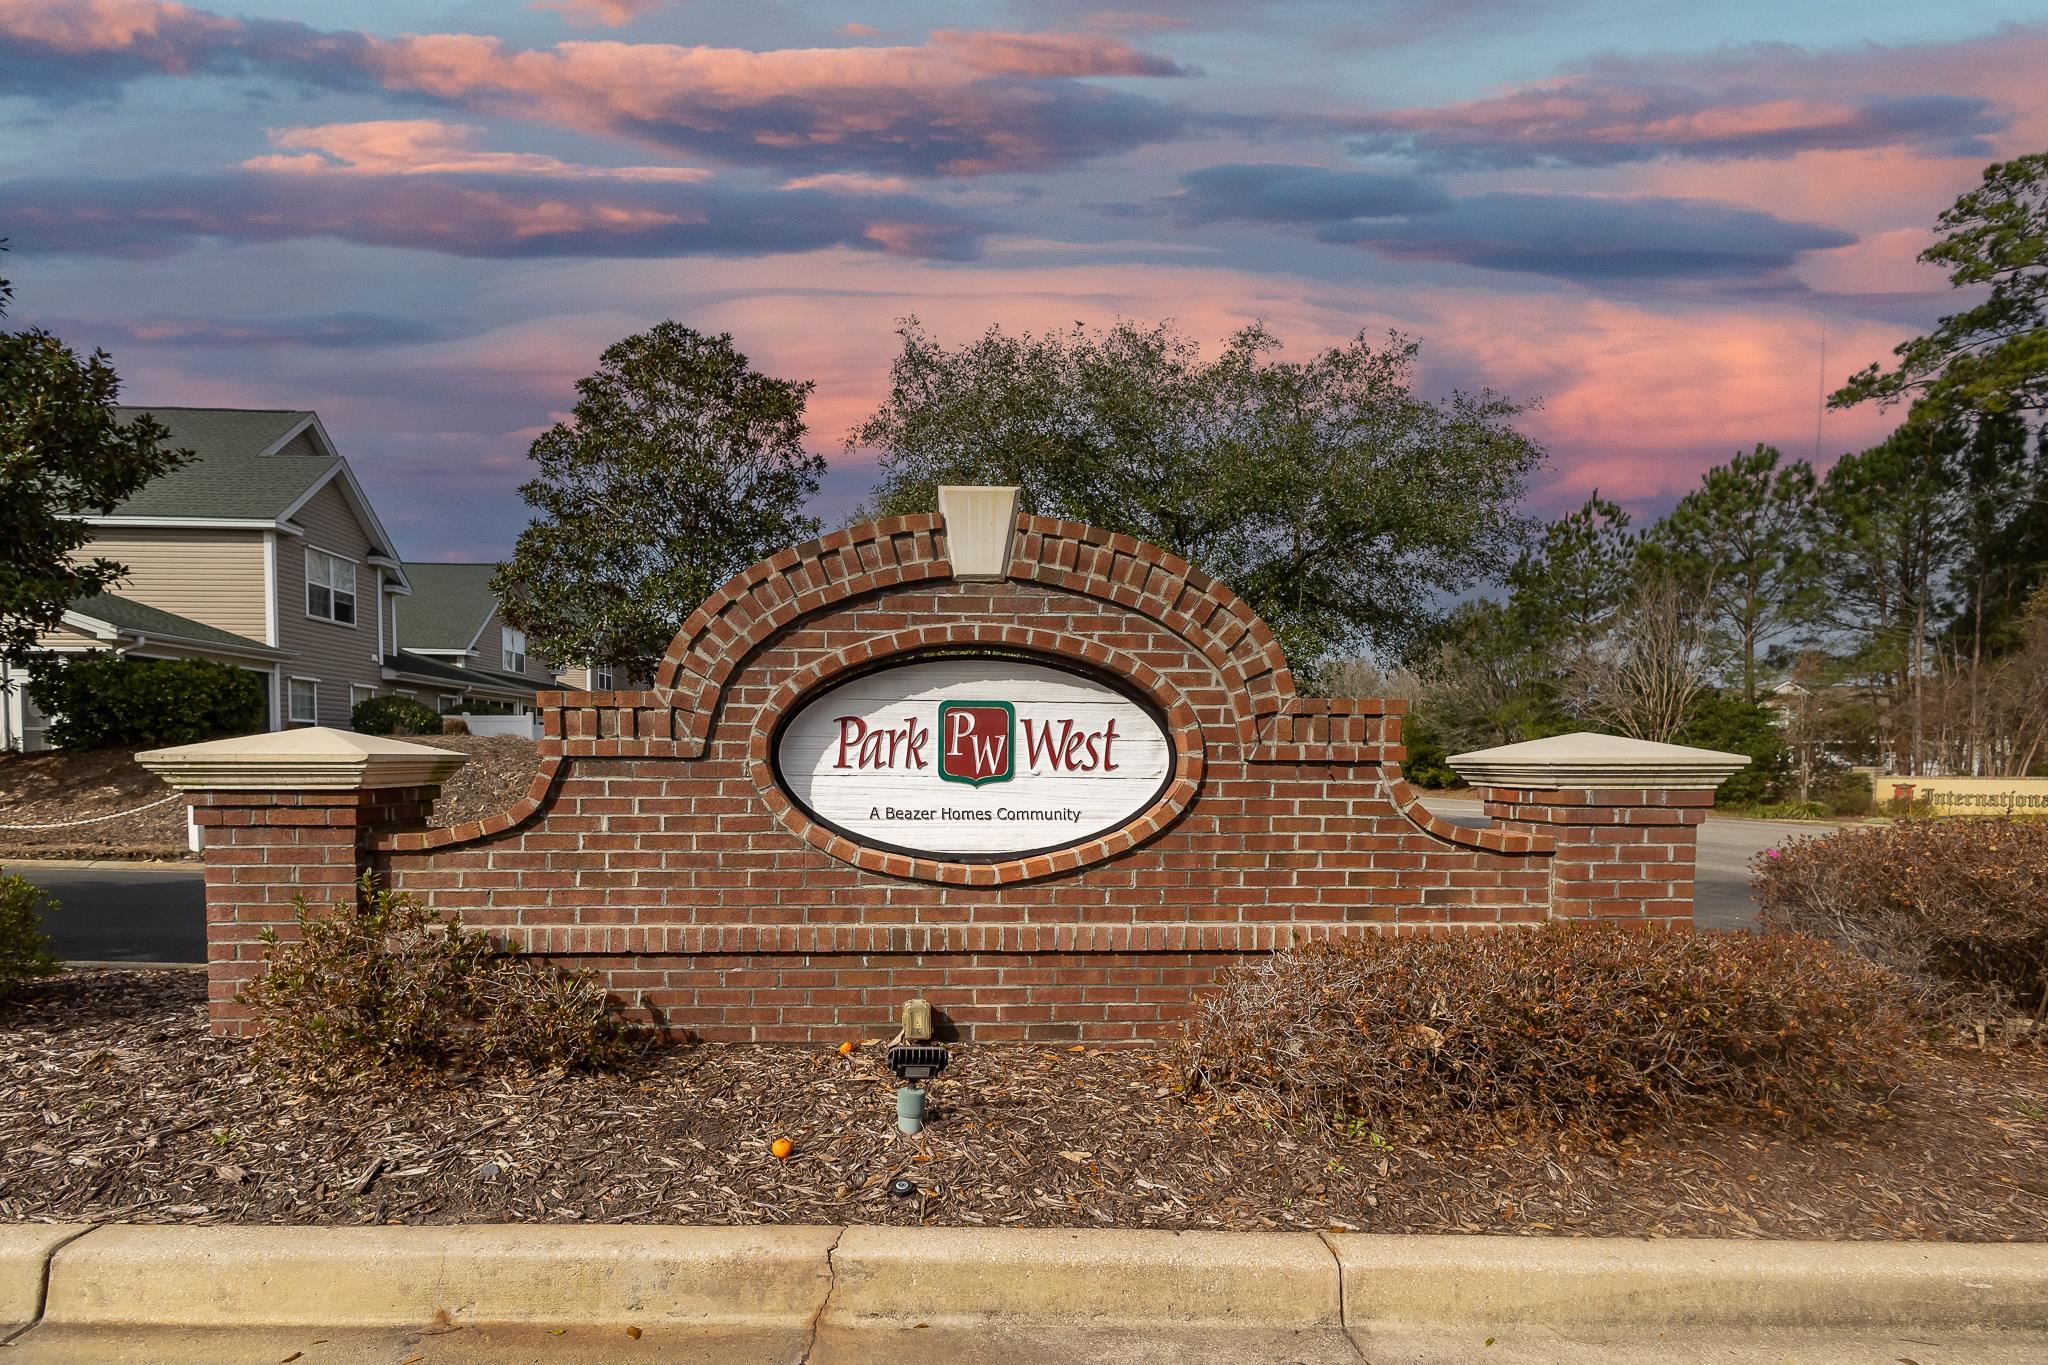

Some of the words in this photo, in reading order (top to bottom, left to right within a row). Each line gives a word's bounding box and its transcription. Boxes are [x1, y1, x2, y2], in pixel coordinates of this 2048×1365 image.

[832, 716, 929, 771] Park
[1020, 718, 1120, 772] West
[870, 807, 880, 820] A
[886, 807, 937, 820] Beazer
[941, 807, 992, 820] Homes
[997, 807, 1082, 823] Community
